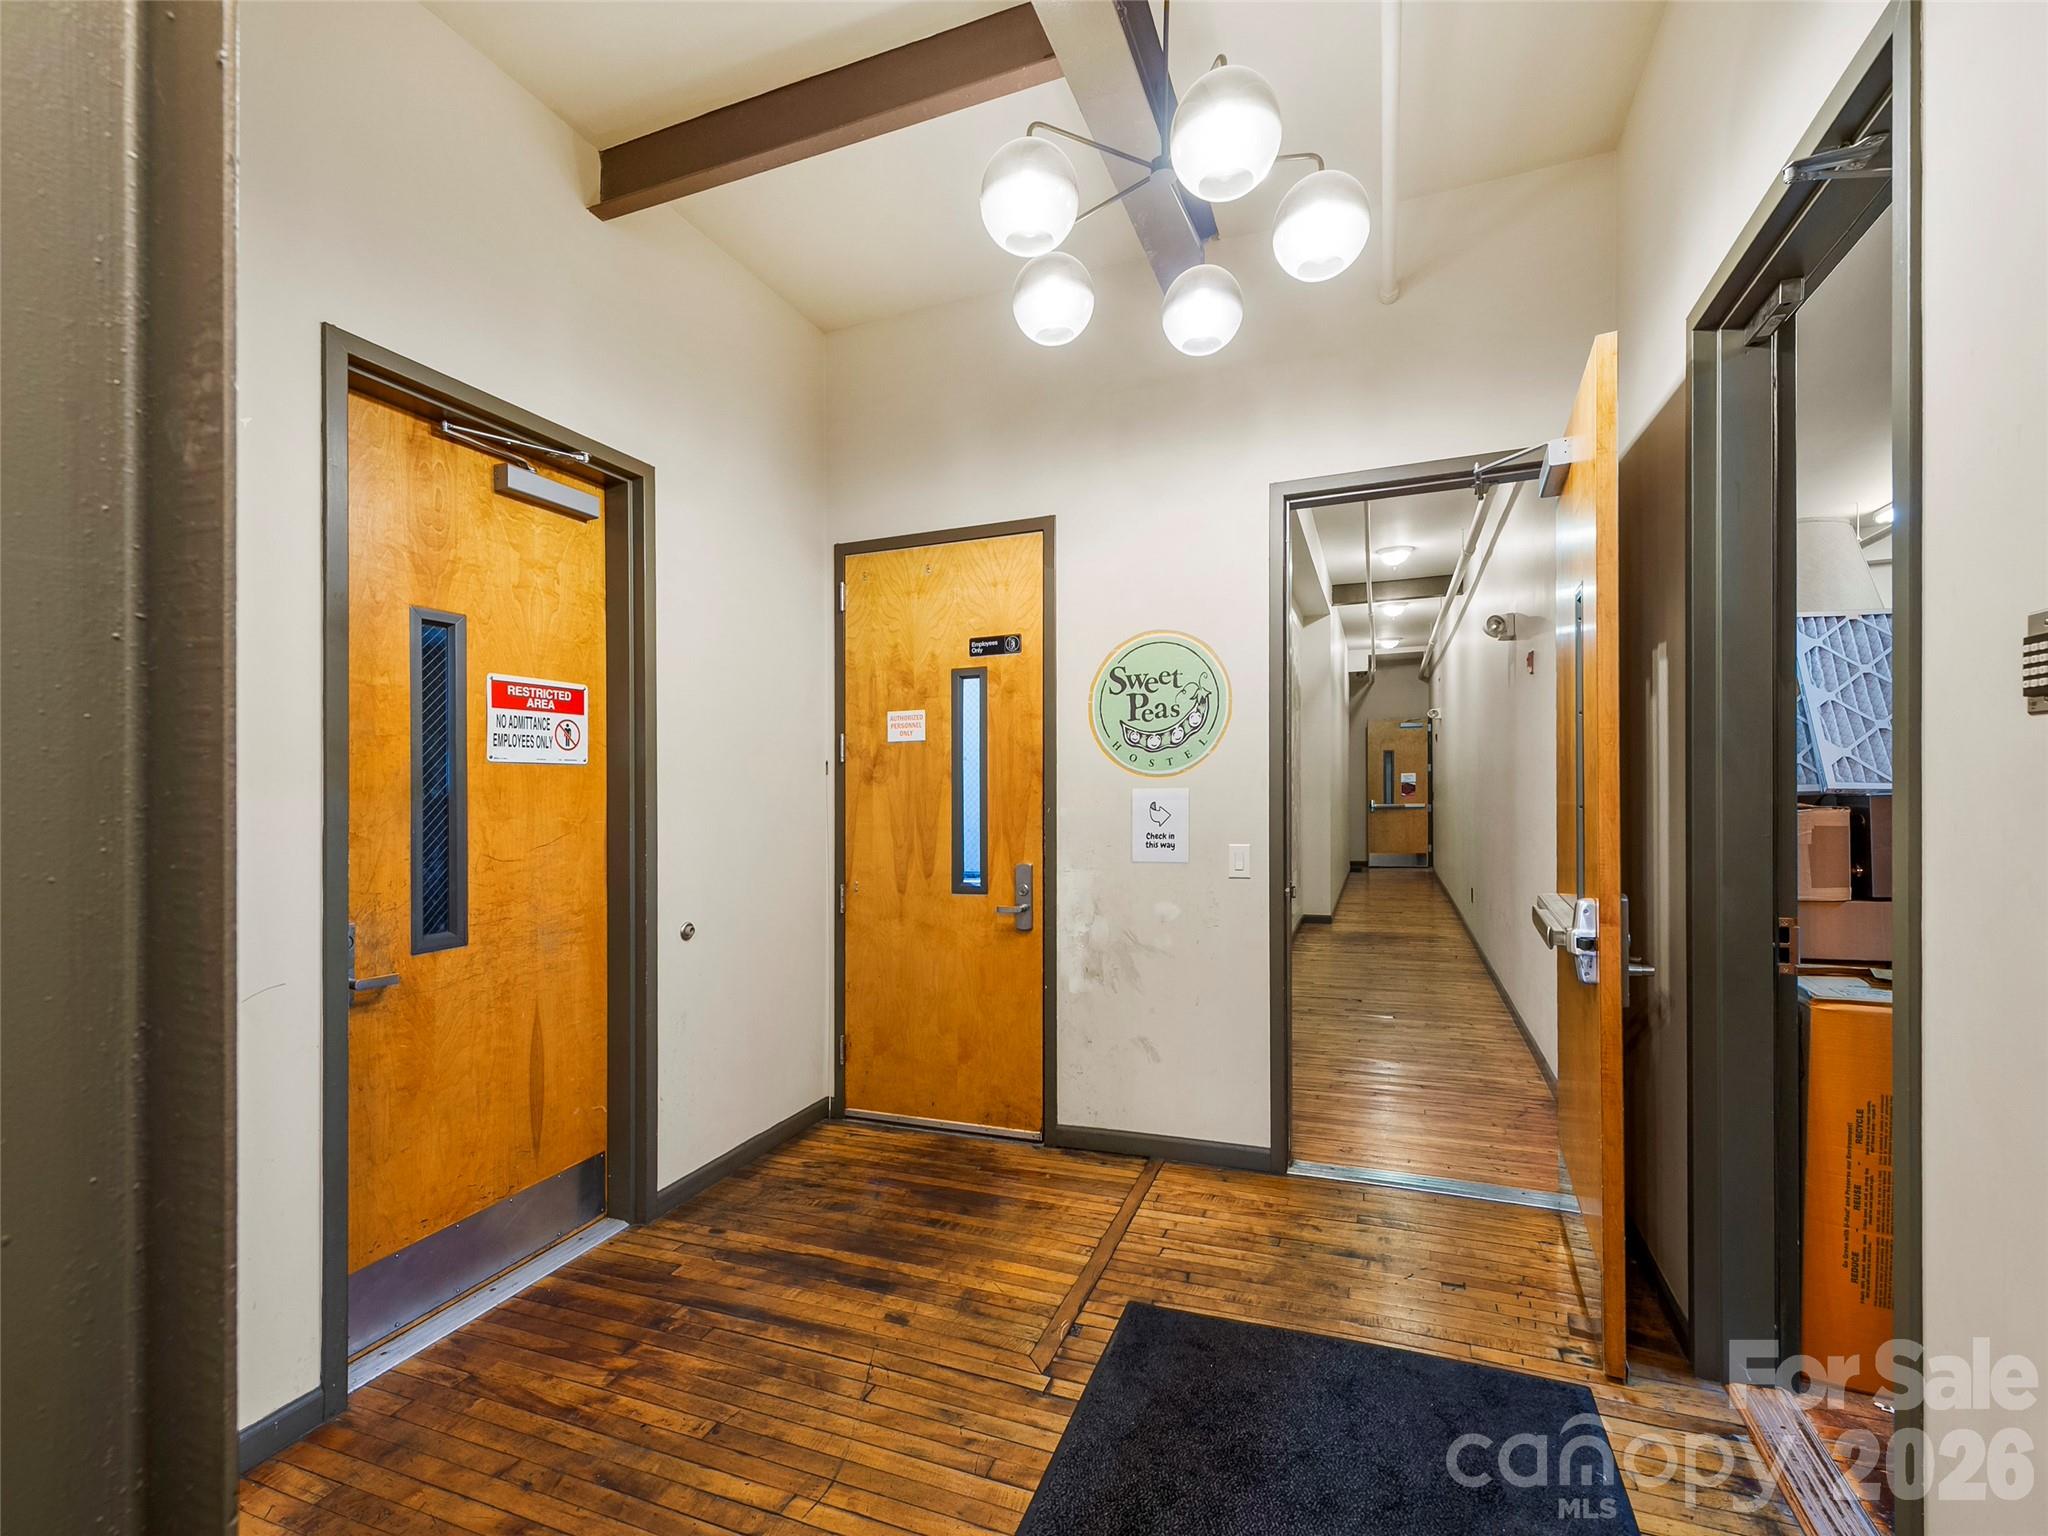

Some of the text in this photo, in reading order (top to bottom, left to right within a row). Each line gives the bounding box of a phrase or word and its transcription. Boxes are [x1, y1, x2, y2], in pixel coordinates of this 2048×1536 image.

[971, 640, 998, 648] Employees
[1108, 666, 1183, 695] Sweet
[507, 685, 572, 701] RESTRICTED
[526, 698, 556, 710] AREA
[1126, 692, 1181, 722] Peas
[496, 714, 551, 731] NO ADMITTANCE
[493, 733, 554, 749] EMPLOYEES ONLY
[1112, 739, 1208, 767] HOSTEL
[1145, 832, 1175, 840] Check in
[1145, 841, 1176, 851] this way
[1855, 1109, 1864, 1145] RECYCLE
[1853, 1184, 1862, 1211] REUSE
[1850, 1251, 1859, 1284] REDUCE
